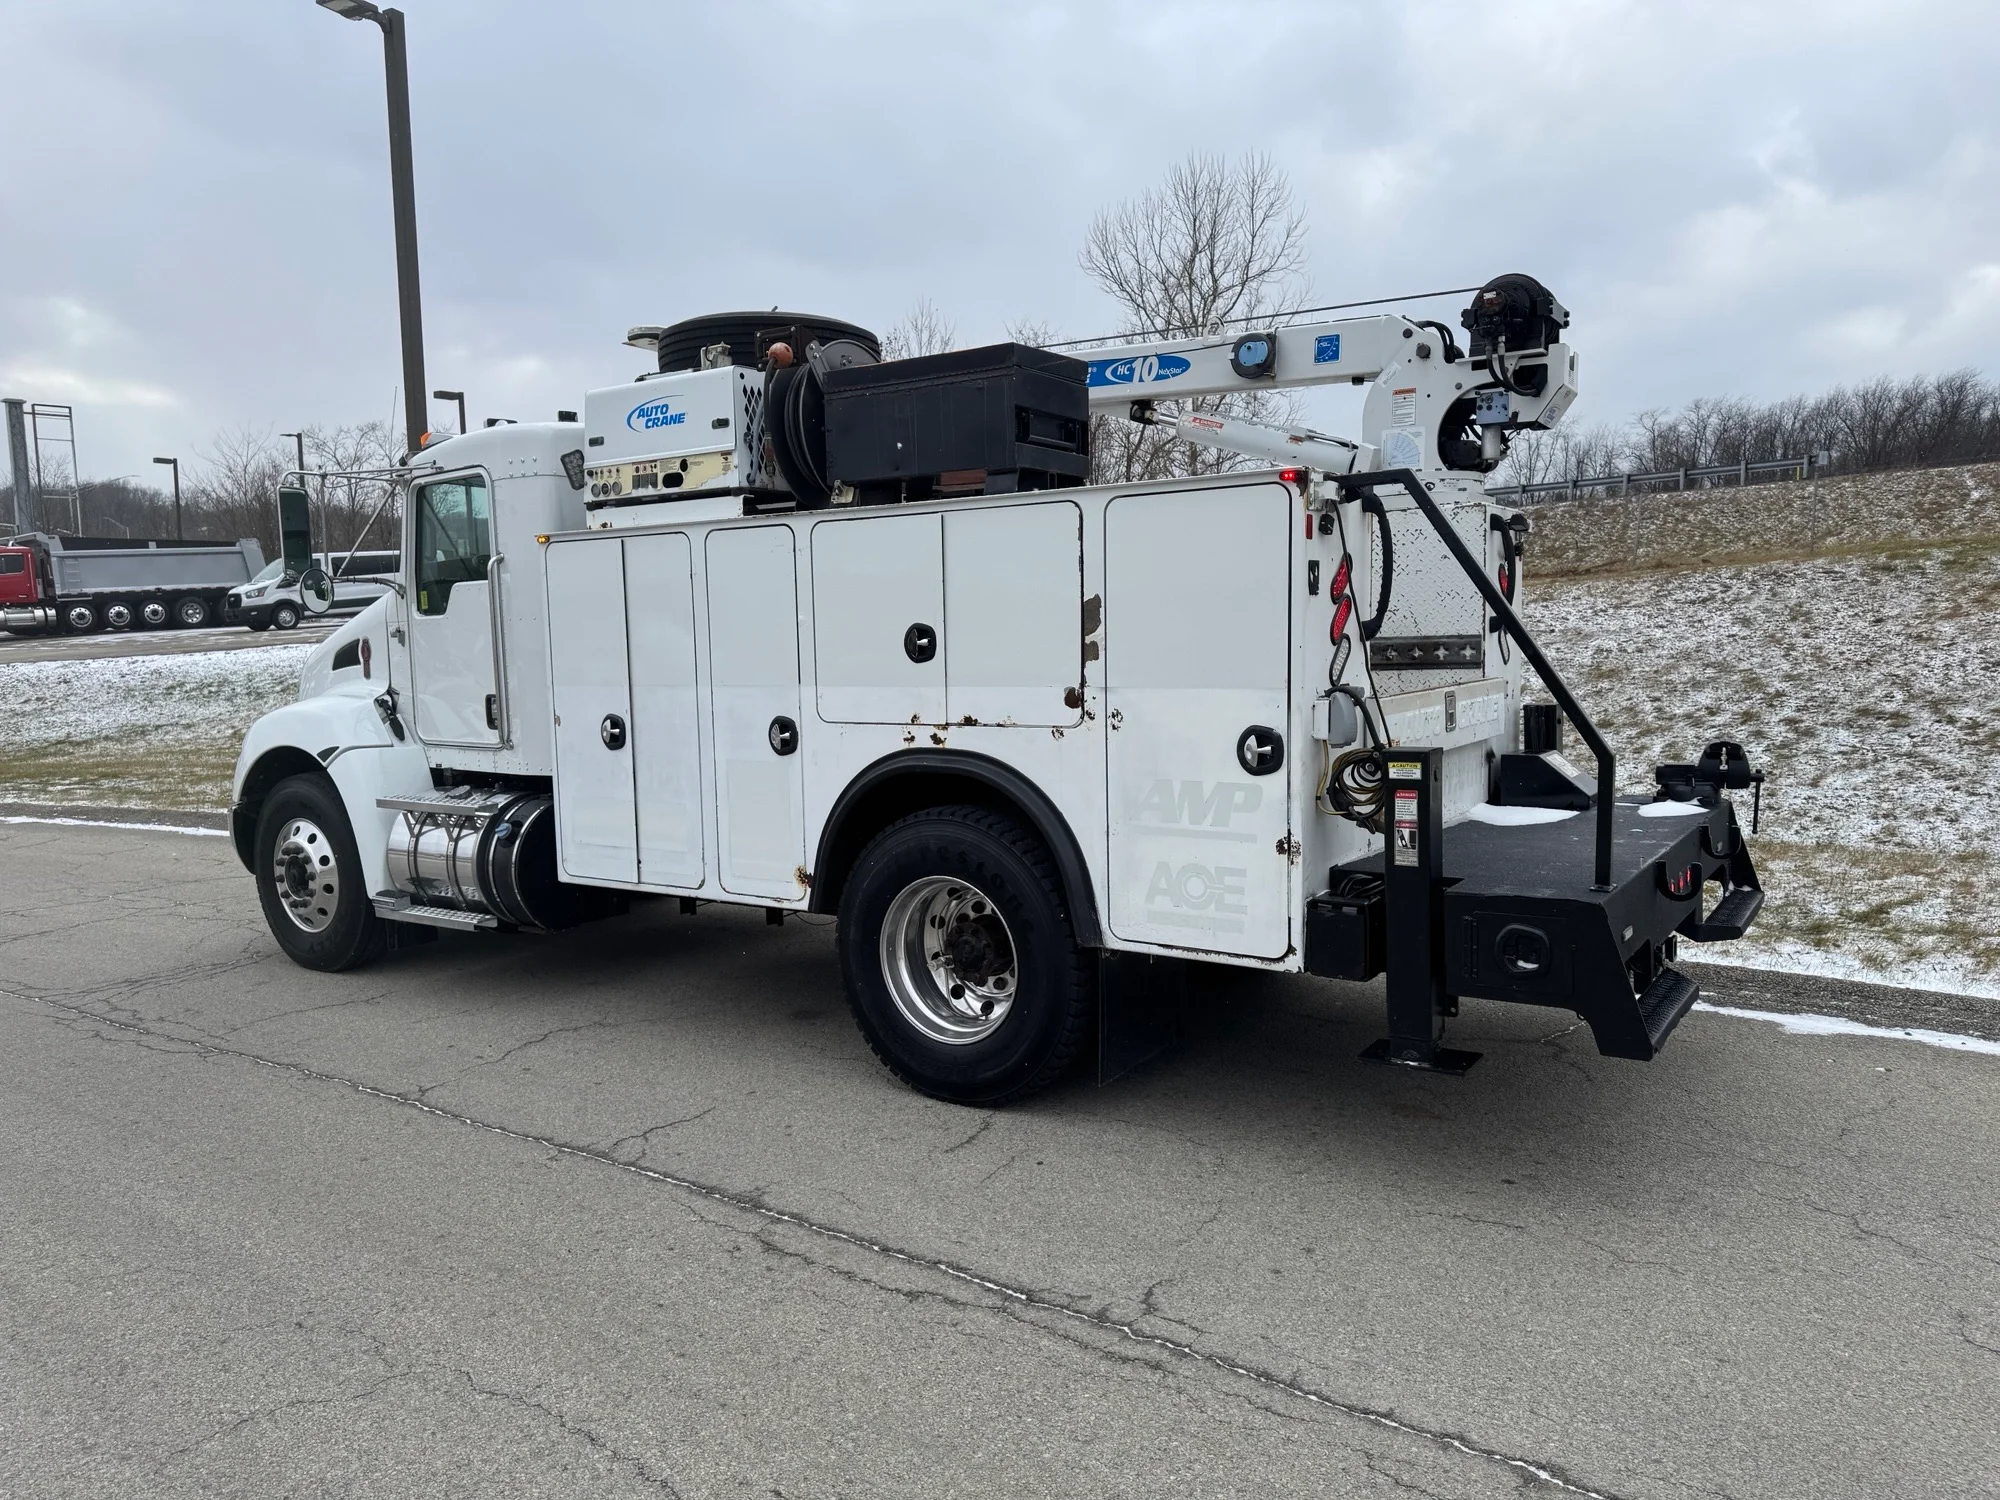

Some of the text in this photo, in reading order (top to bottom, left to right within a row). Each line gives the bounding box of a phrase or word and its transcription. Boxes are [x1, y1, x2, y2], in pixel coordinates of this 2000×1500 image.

[1117, 364, 1131, 375] HC
[1131, 356, 1159, 384] 10
[636, 403, 669, 419] AUTO
[644, 412, 686, 429] CRANE
[1129, 779, 1263, 827] AMP
[1144, 861, 1247, 915] ACE
